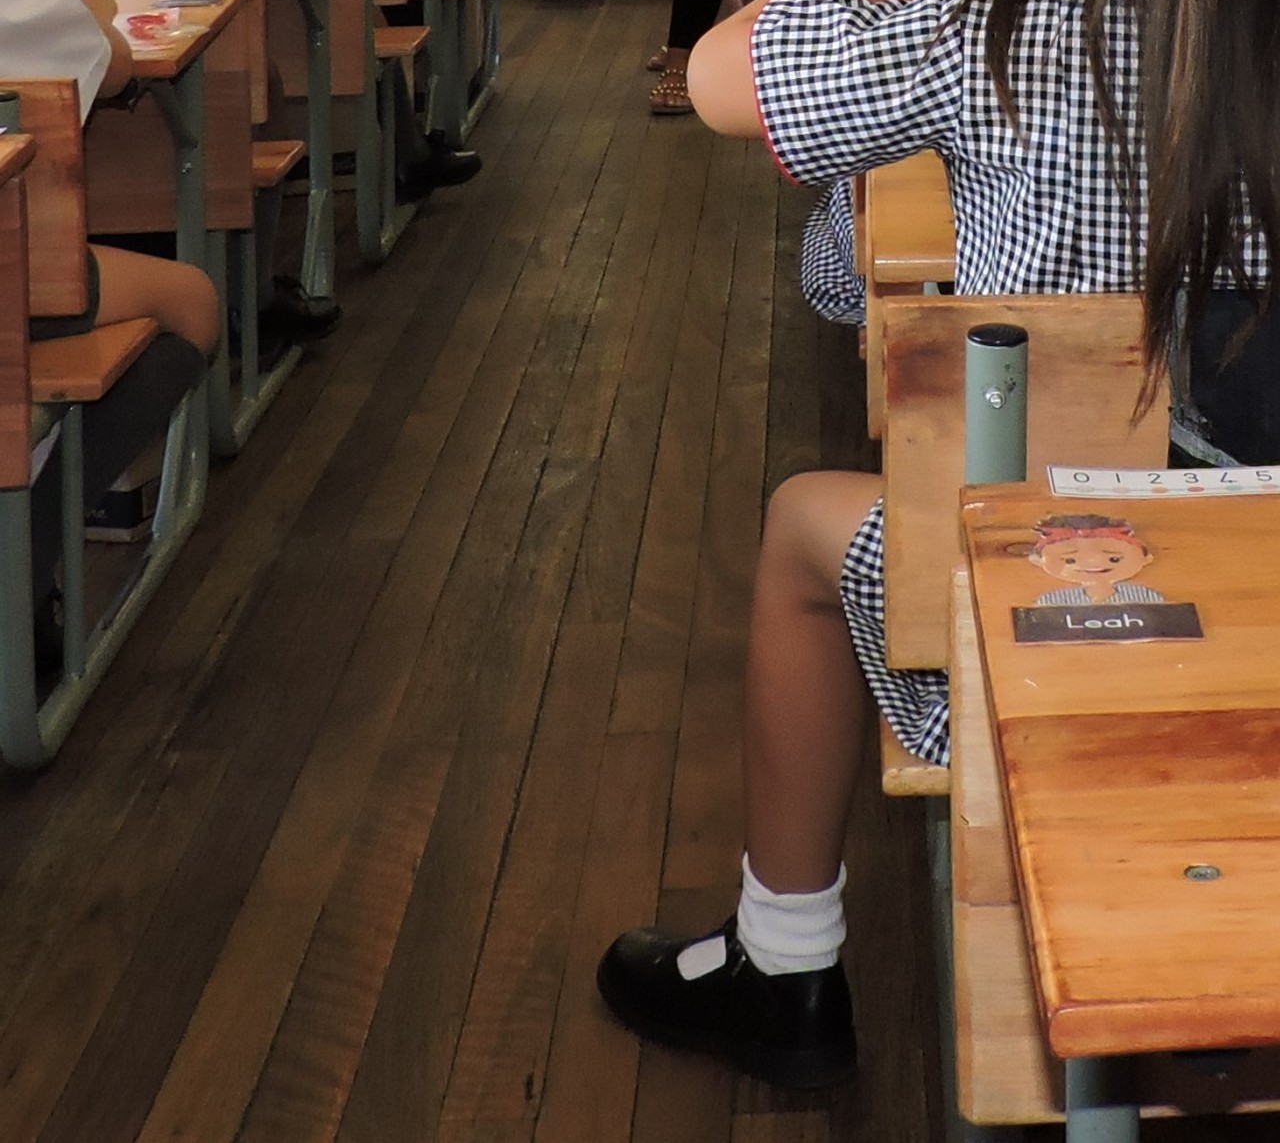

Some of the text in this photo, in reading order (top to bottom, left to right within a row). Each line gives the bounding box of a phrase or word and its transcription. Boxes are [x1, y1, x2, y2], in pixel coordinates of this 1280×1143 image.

[1073, 472, 1090, 483] 0
[1148, 473, 1162, 484] 2
[1184, 472, 1199, 484] 3
[1220, 471, 1237, 483] 4
[1256, 470, 1273, 482] 5
[1066, 614, 1144, 629] Leah
